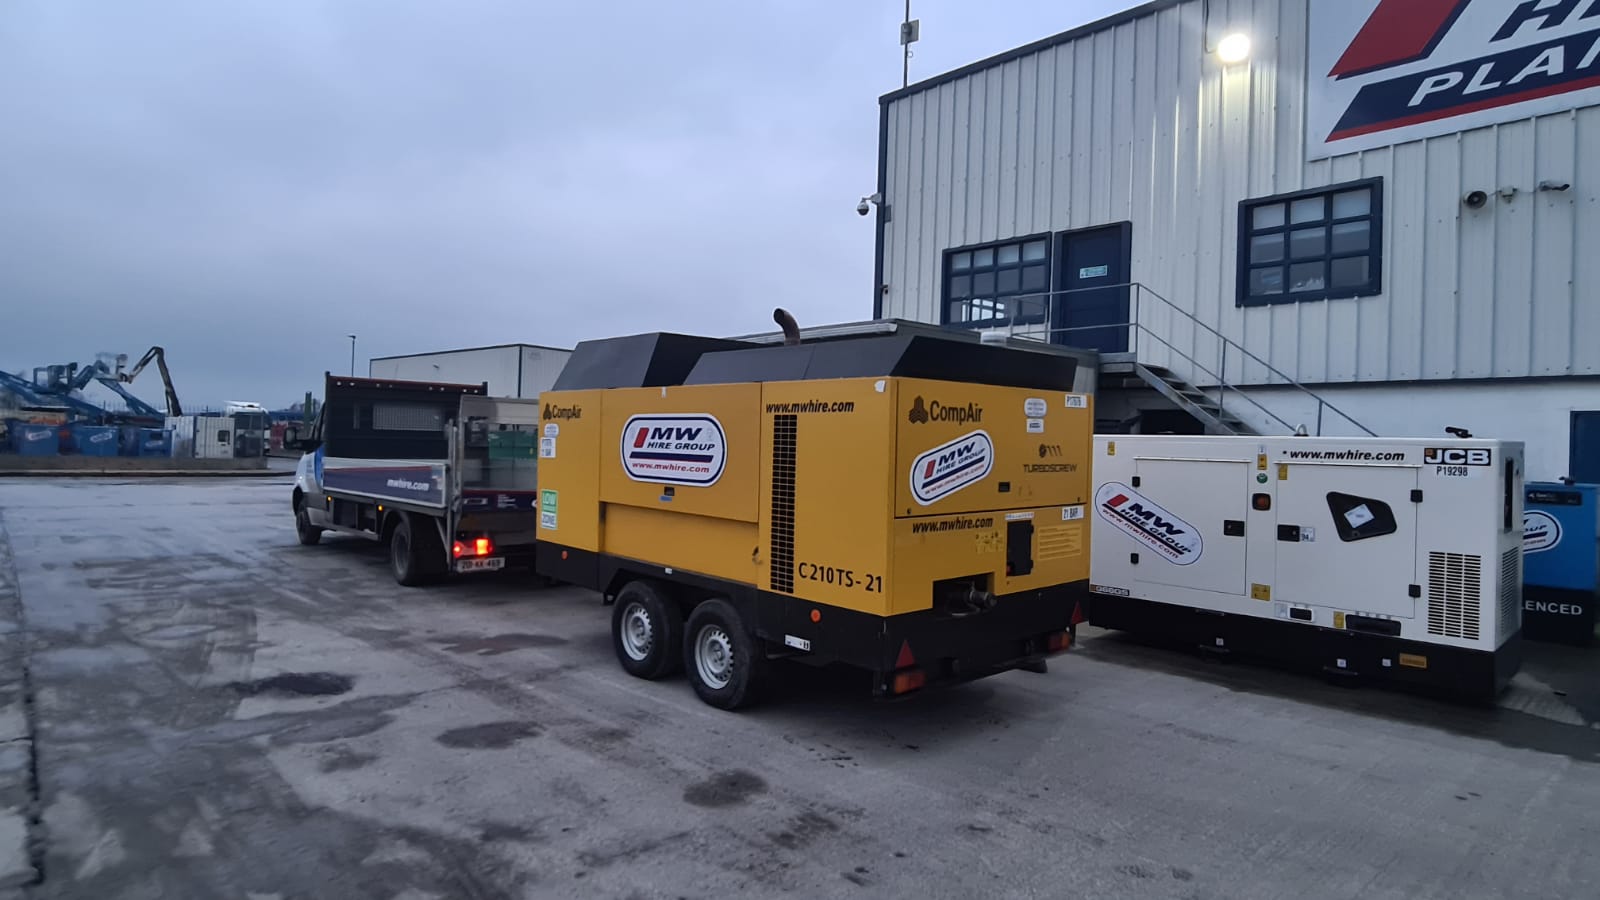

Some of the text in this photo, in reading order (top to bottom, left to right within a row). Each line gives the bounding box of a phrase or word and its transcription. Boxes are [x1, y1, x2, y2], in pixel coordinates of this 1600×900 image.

[552, 405, 582, 420] CompAir
[766, 400, 855, 413] www.mwhire.com
[930, 400, 983, 426] CompAir
[651, 427, 703, 441] MW
[647, 442, 715, 451] HIRE GROUP
[938, 441, 976, 466] MW
[936, 448, 986, 474] HIRE GROUP
[1290, 450, 1405, 461] www.mwhire.com
[1426, 449, 1489, 464] JCB
[632, 462, 710, 473] www.mwhire.com
[1023, 464, 1078, 473] TURBOSCREW
[1436, 466, 1468, 477] P19298
[387, 479, 430, 491] mwhire.com
[912, 517, 993, 533] www.mwhire.com
[1128, 502, 1185, 535] MW
[1120, 509, 1191, 553] HIRE GROUP
[1521, 600, 1582, 615] ENCED
